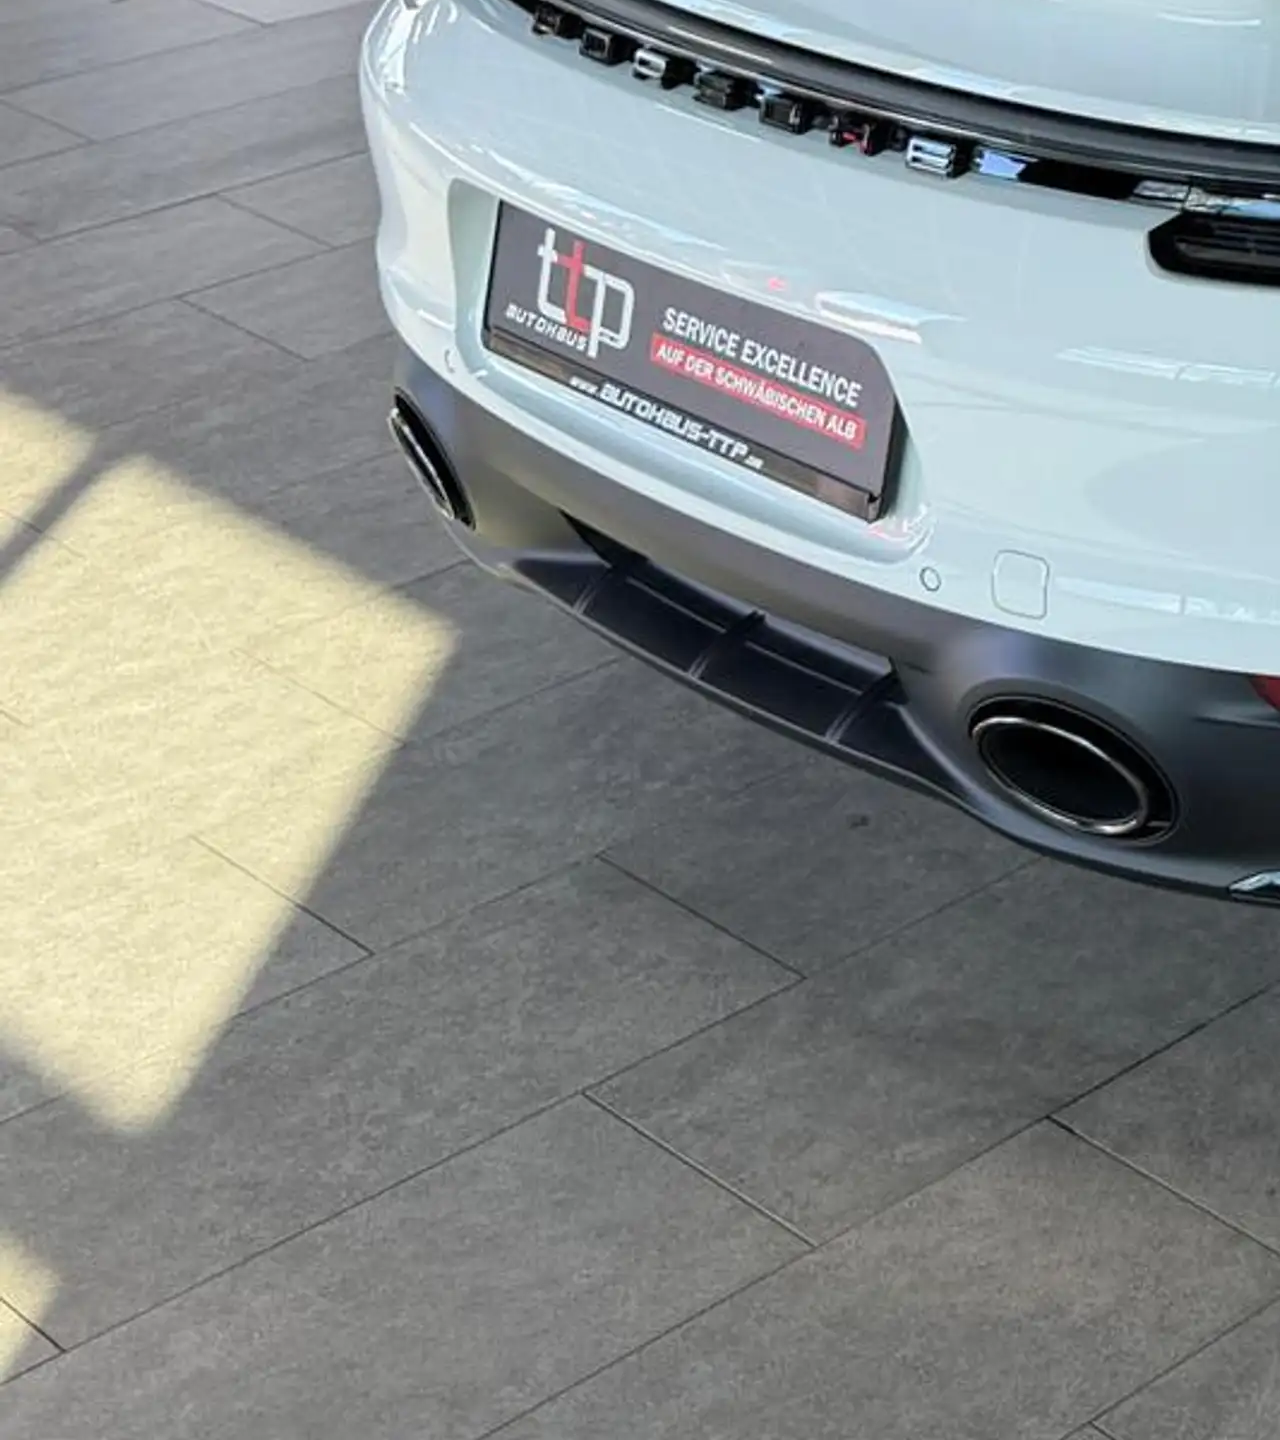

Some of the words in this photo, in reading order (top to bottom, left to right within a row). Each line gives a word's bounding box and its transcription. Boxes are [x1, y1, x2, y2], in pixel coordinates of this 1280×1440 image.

[537, 228, 635, 358] ttp
[656, 343, 685, 366] AUF
[684, 355, 714, 380] DER
[826, 414, 857, 441] ALB
[663, 307, 740, 357] SERVICE
[740, 339, 862, 408] EXCELLENCE
